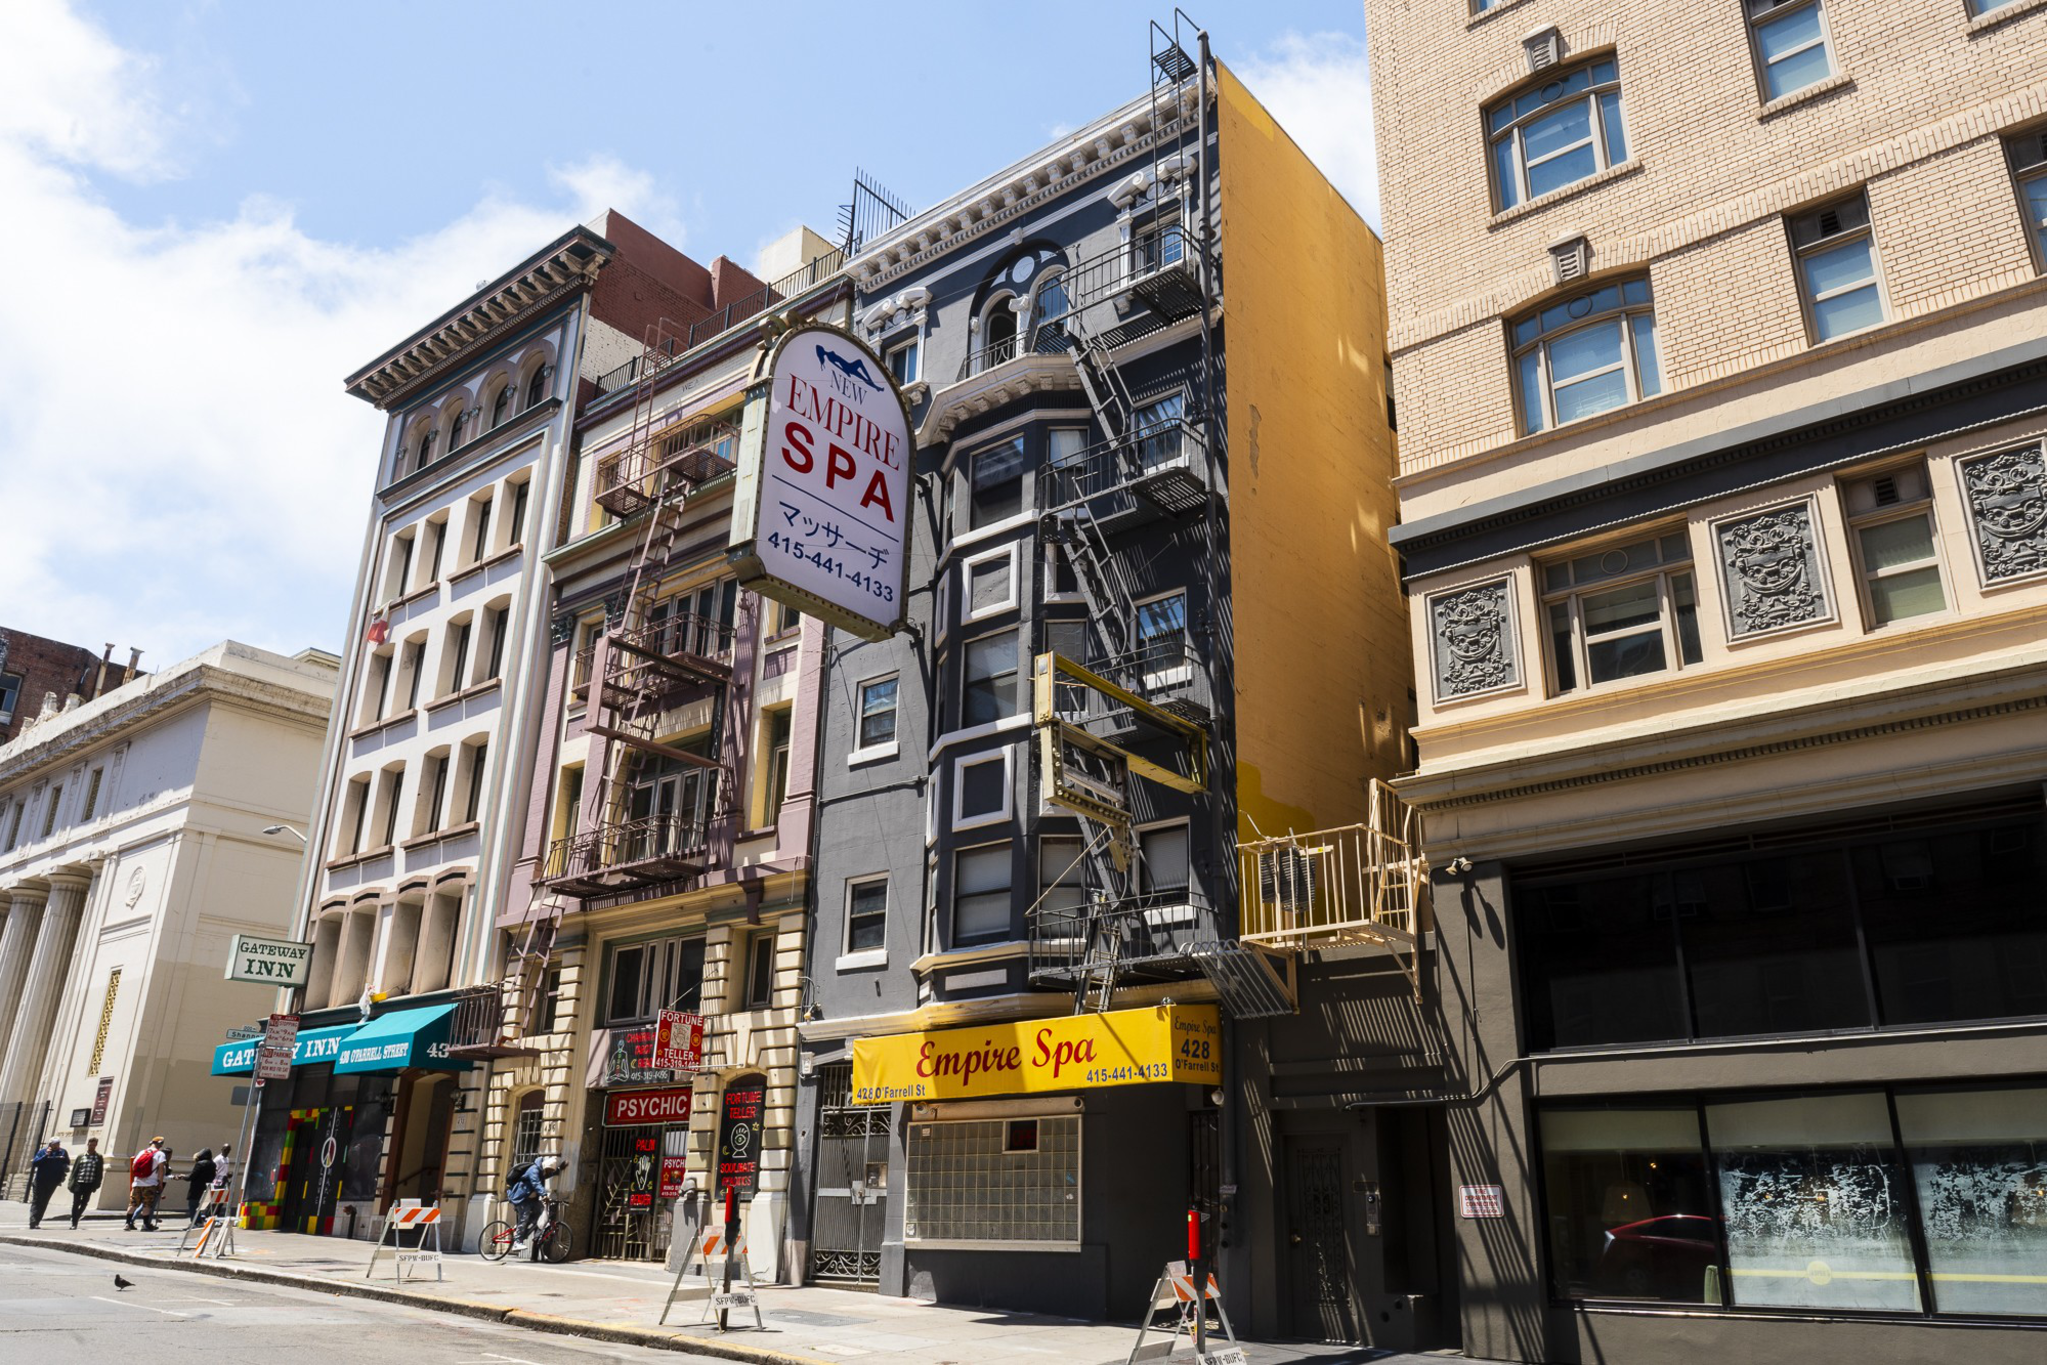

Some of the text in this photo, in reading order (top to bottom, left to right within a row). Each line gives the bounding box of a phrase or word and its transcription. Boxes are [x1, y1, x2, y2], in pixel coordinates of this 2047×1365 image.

[830, 370, 868, 405] NEW
[786, 373, 900, 471] EMPIRE
[781, 421, 895, 523] SPA
[767, 531, 894, 602] 415-441-4133
[240, 942, 308, 960] GATEWAY
[244, 958, 296, 978] INN
[660, 1012, 704, 1026] FORTUNE
[1174, 1016, 1217, 1038] Empire Spa
[305, 1037, 342, 1058] INN
[383, 1042, 409, 1059] STREET
[426, 1042, 460, 1058] 43
[664, 1048, 694, 1060] TELLER
[1181, 1038, 1210, 1059] 428
[916, 1028, 1097, 1086] Empire Spa
[1176, 1059, 1219, 1073] O'Farrell St
[1087, 1063, 1168, 1083] 415-441-4133
[726, 1091, 762, 1105] FORTUNE
[857, 1084, 925, 1099] 428 O'Farrell St
[617, 1096, 688, 1117] PSYCHIC
[729, 1106, 758, 1119] TELLER
[636, 1139, 655, 1151] PALM
[720, 1162, 756, 1174] SOULMATE
[630, 1194, 652, 1205] READER
